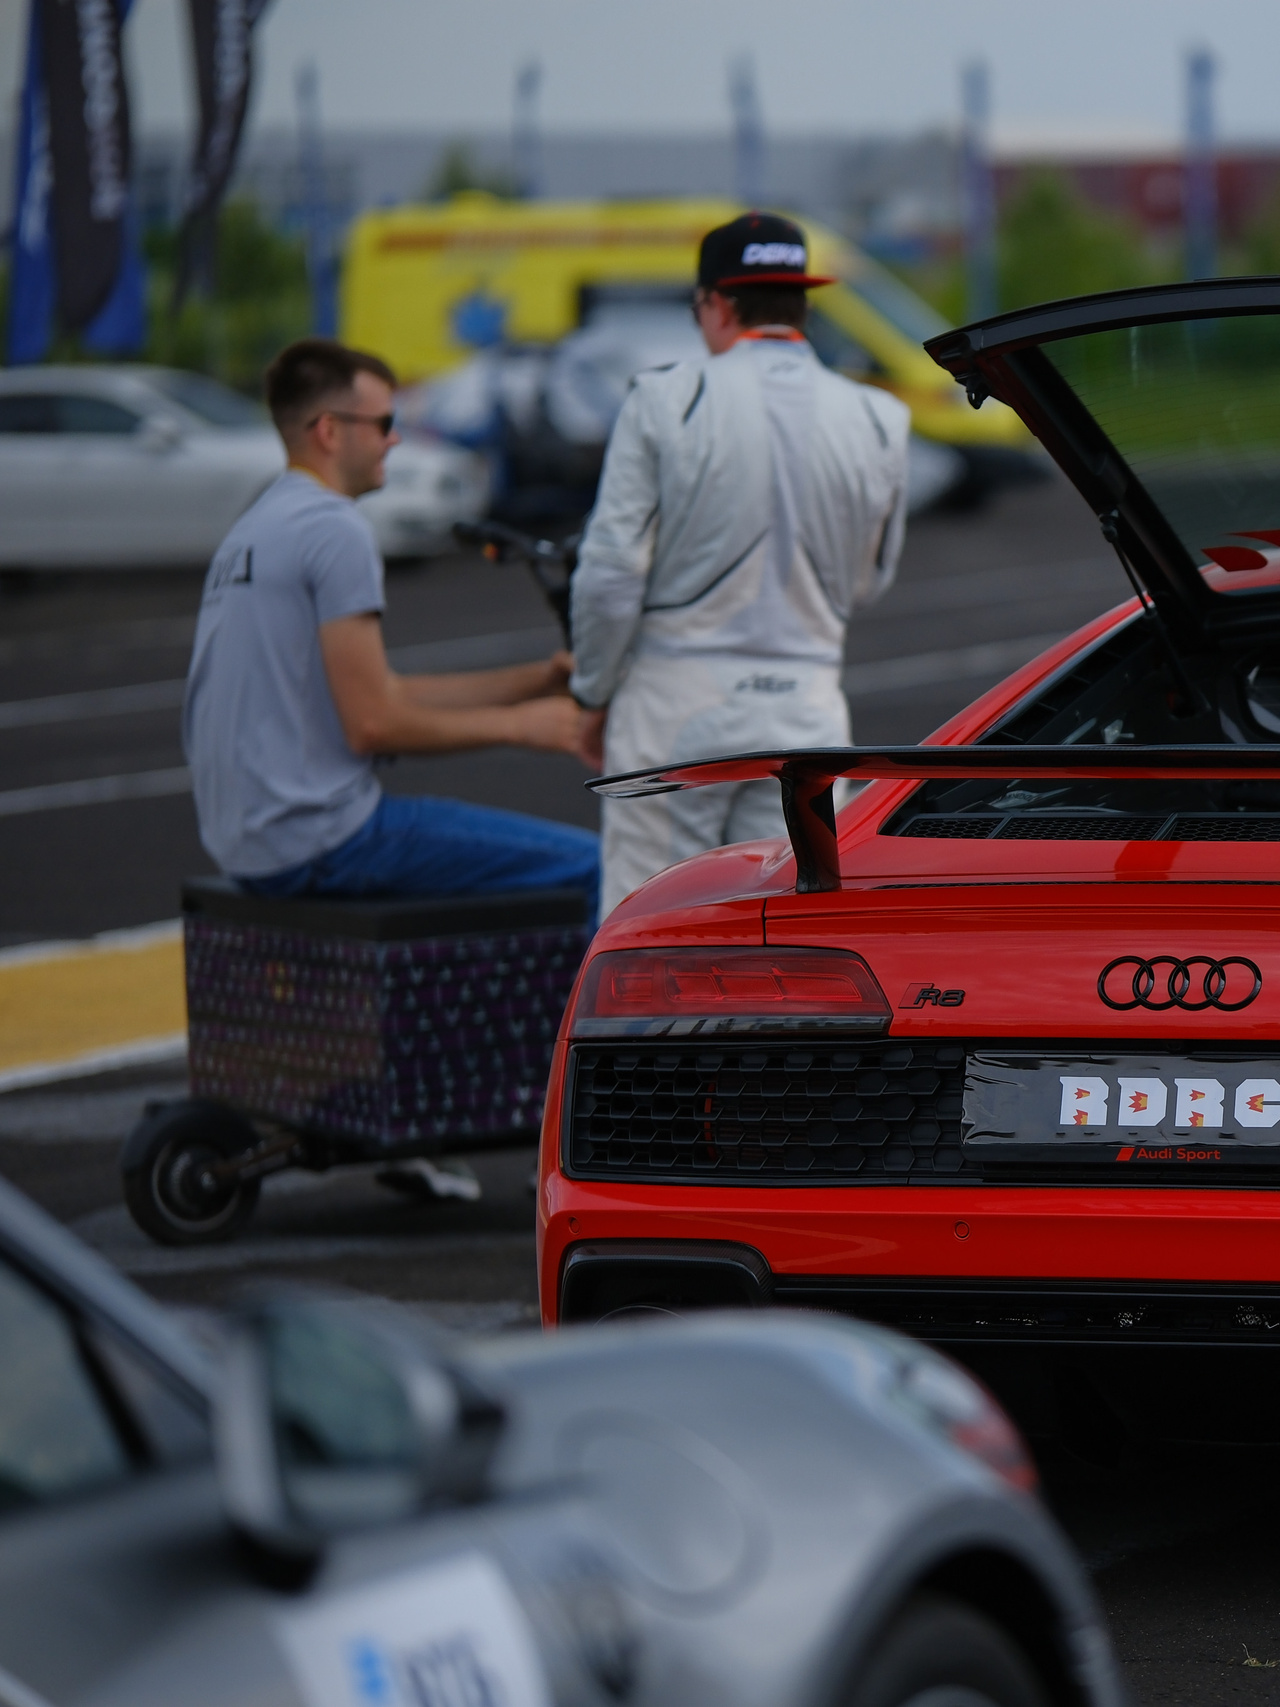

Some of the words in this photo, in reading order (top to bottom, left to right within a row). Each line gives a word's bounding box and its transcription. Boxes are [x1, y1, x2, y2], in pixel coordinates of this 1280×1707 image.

[912, 988, 966, 1007] R8
[1136, 1147, 1173, 1160] Audi
[1176, 1147, 1221, 1162] Sport
